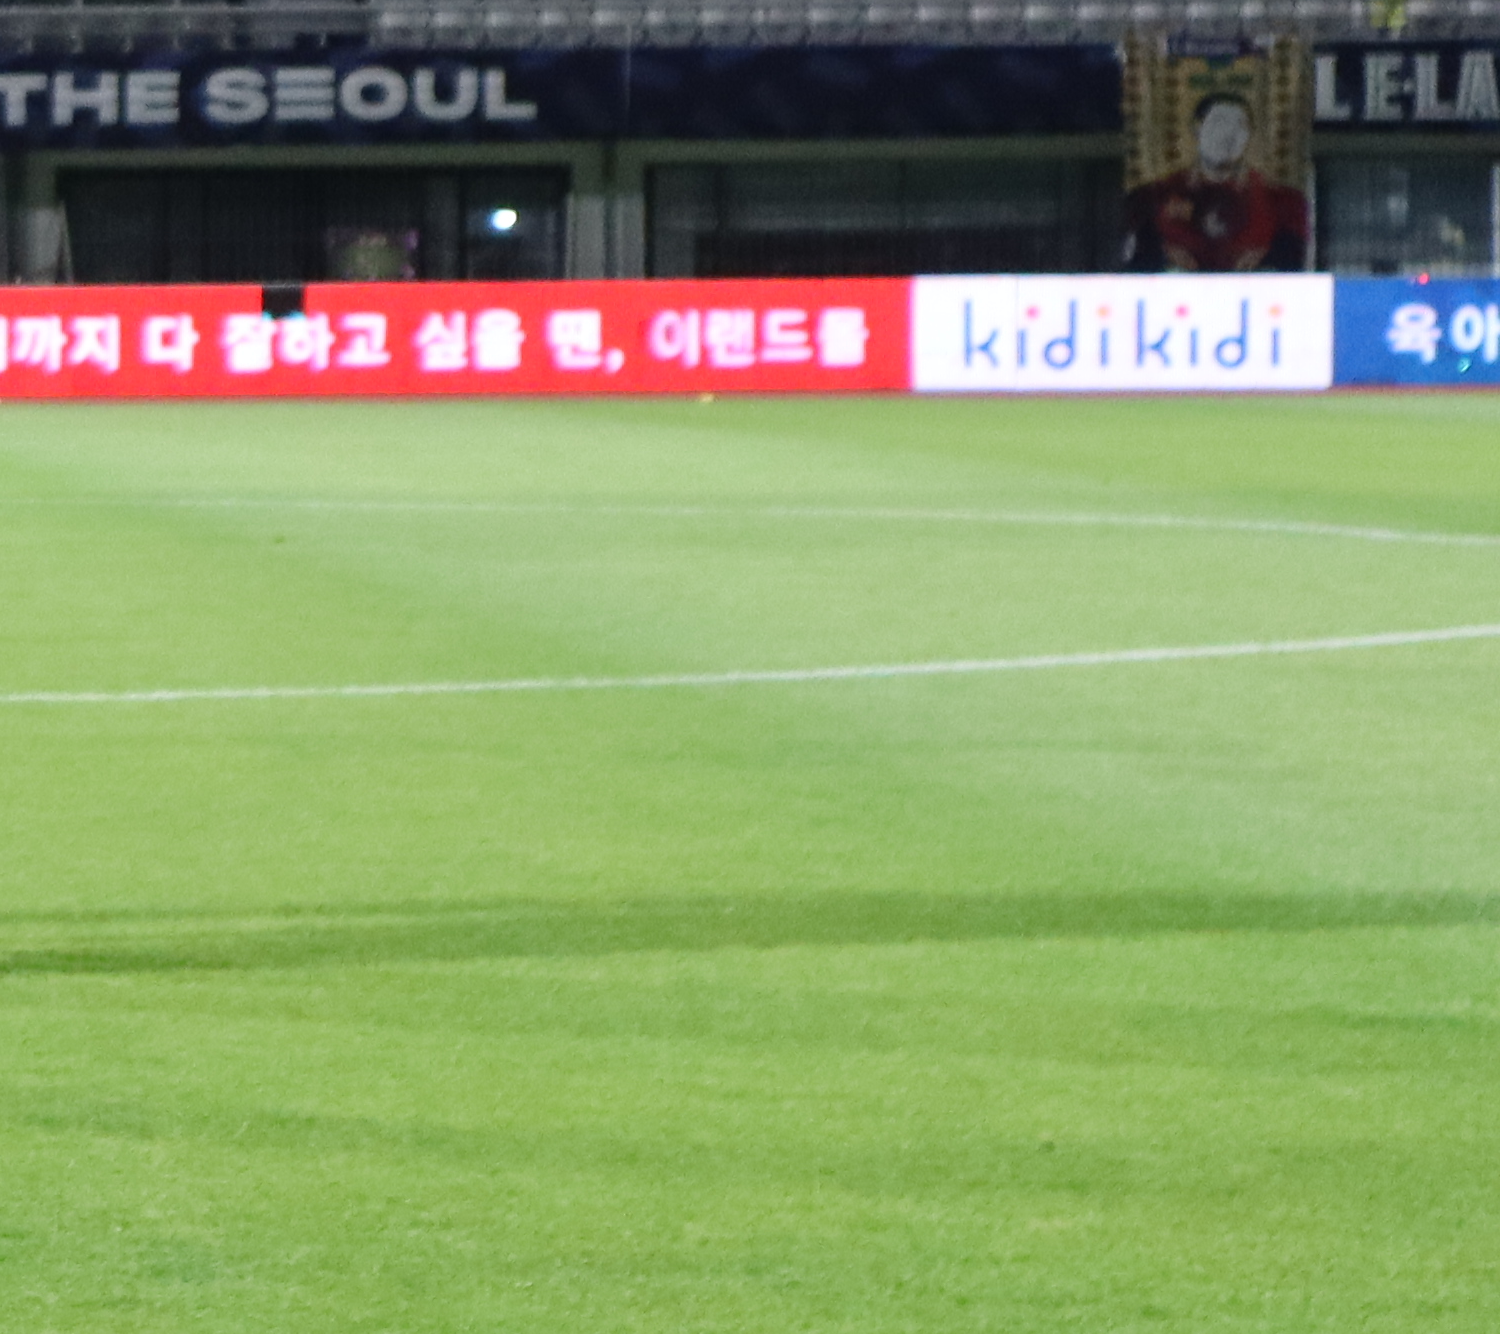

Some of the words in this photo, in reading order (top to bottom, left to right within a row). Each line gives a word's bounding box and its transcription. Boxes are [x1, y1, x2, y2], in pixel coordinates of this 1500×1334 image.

[206, 66, 538, 124] SEOUL
[140, 315, 200, 373] 다
[648, 308, 869, 369] 이랜드몰
[963, 299, 1282, 371] kidikidi
